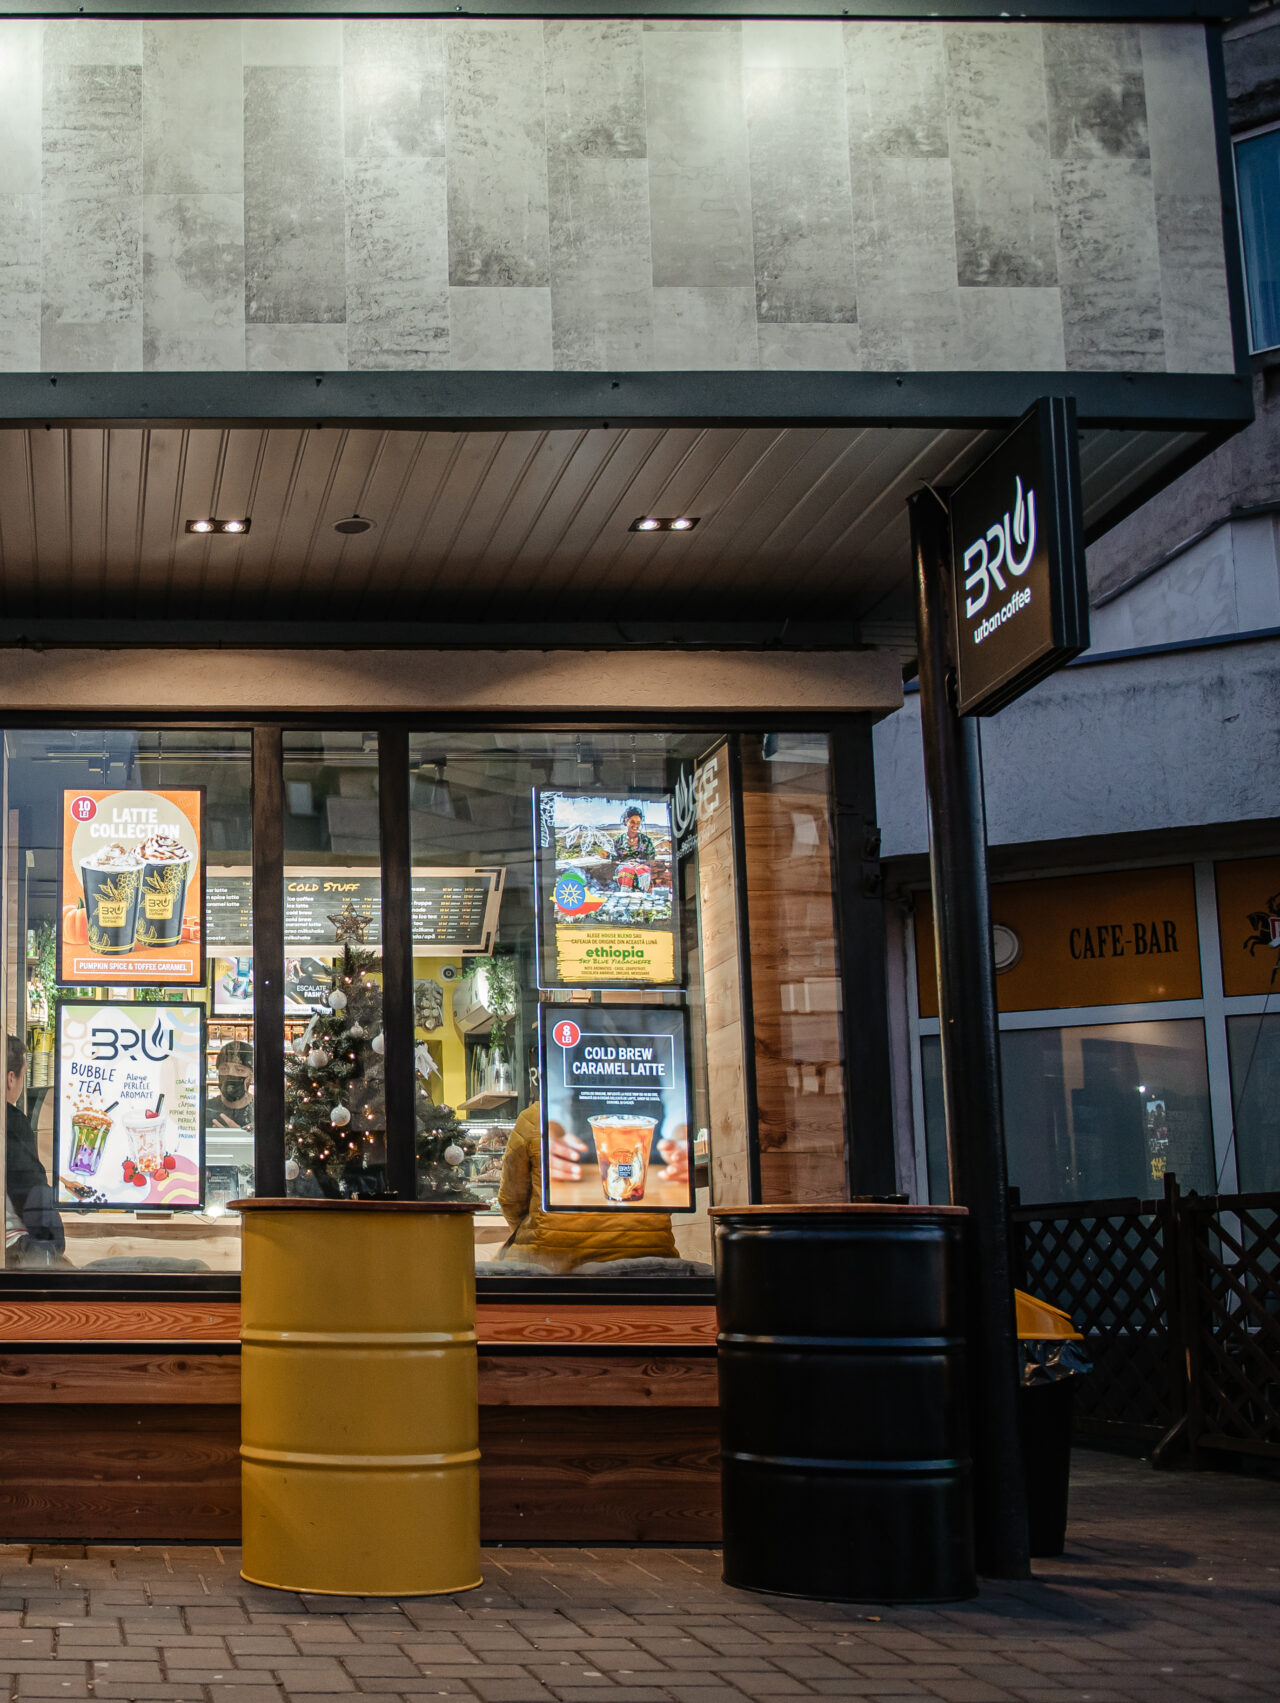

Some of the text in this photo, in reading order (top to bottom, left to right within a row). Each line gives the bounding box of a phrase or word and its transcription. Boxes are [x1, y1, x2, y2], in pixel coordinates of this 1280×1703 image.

[963, 488, 1037, 619] BRU
[78, 801, 91, 811] 10
[112, 807, 158, 824] LATTE
[89, 823, 181, 840] COLLECTION
[287, 881, 361, 892] COLD STUFF
[101, 905, 124, 915] BRU
[148, 898, 170, 908] BRU
[1069, 919, 1180, 961] CAFE-BAR
[585, 945, 644, 960] ethiopia
[79, 962, 109, 970] PUMPKIN
[109, 962, 127, 970] SPICE
[134, 963, 157, 971] TOFFEE
[157, 963, 188, 971] CARAMEL
[296, 984, 327, 992] ESCALATE
[562, 1024, 571, 1036] 8
[91, 1028, 174, 1062] BRU
[561, 1035, 572, 1043] LEI
[584, 1046, 653, 1061] COLD BREW
[71, 1061, 117, 1082] BUBBLE
[572, 1062, 666, 1077] CARAMEL LATTE
[78, 1080, 103, 1096] TEA
[120, 1090, 153, 1099] AROMATE
